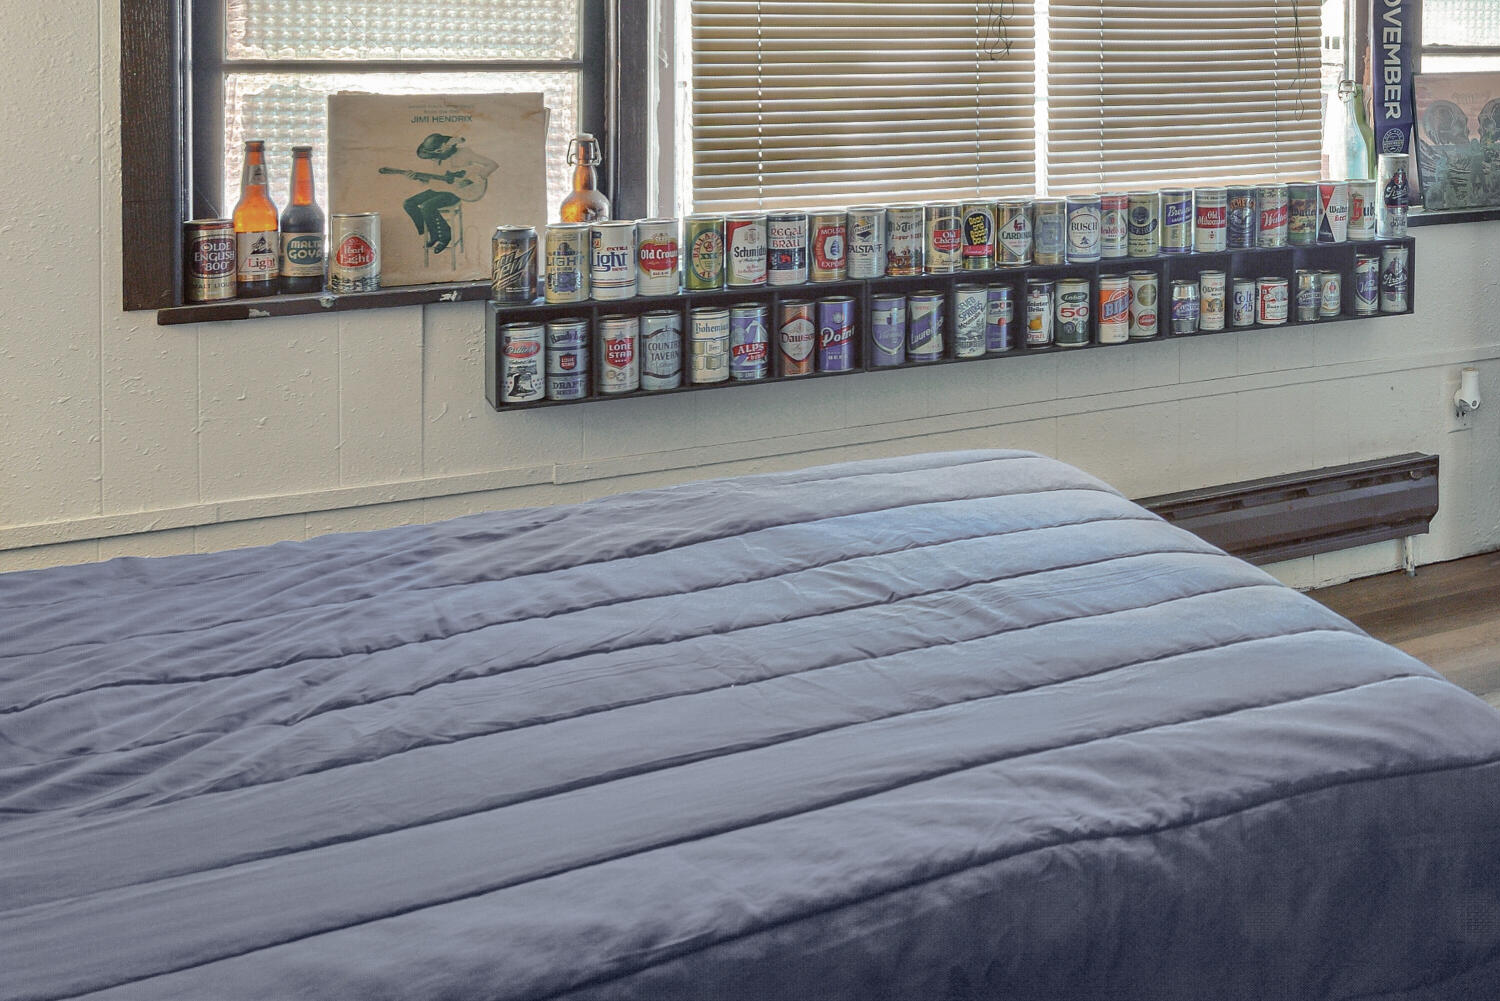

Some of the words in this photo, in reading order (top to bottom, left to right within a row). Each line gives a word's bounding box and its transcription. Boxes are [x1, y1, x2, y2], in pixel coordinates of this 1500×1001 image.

[411, 115, 430, 123] JIMI
[432, 114, 473, 123] HENDRIX
[1071, 221, 1098, 232] BUSCH
[199, 241, 231, 252] OLDE
[194, 251, 235, 263] ENGLISH
[640, 249, 655, 260] Old
[247, 257, 276, 270] Light
[1060, 307, 1089, 318] 50
[820, 326, 855, 347] Point
[608, 343, 632, 351] LONE
[737, 342, 765, 355] ALPS
[608, 350, 632, 359] STAR
